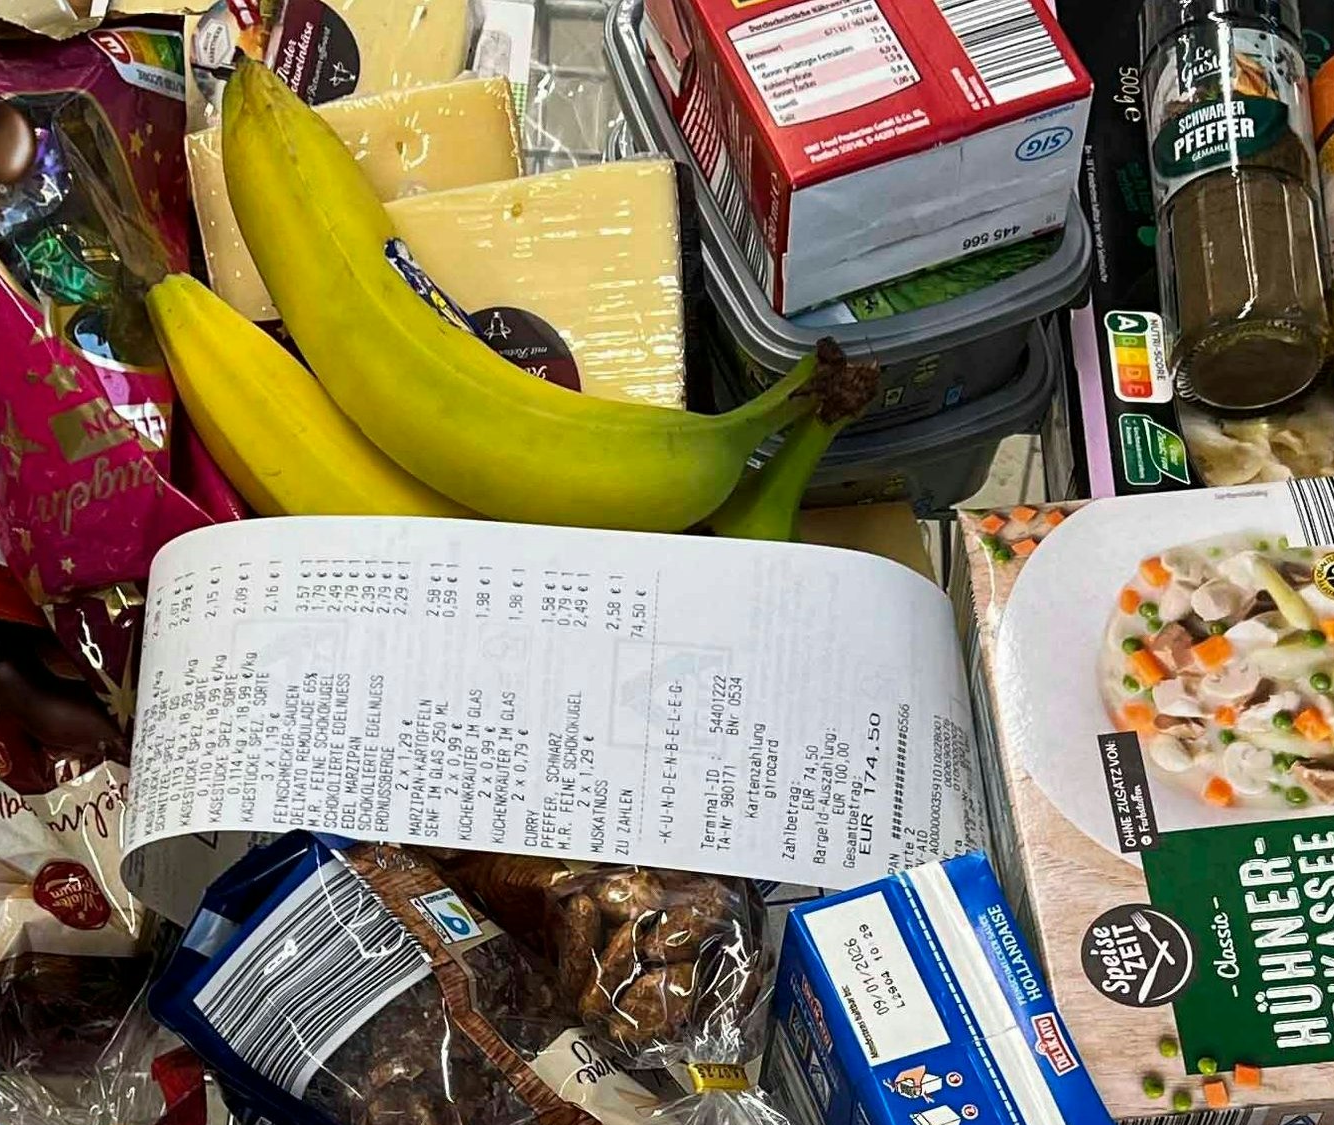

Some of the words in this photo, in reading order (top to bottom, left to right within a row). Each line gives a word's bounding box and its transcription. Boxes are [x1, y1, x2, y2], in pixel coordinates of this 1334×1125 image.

[1026, 135, 1063, 157] SIG
[1174, 118, 1254, 161] PFEFFER
[962, 231, 988, 250] 566
[994, 224, 1020, 240] 445
[1116, 312, 1139, 331] A
[1146, 318, 1168, 381] NUTRI-SCORE
[327, 584, 342, 612] 2,49
[442, 589, 457, 617] 0,59
[475, 591, 490, 618] 1,98
[557, 596, 572, 626] 0,79
[631, 603, 646, 637] 74,50
[303, 671, 317, 693] 65%
[467, 688, 482, 718] GLAS
[727, 676, 742, 706] 0534
[314, 673, 334, 749] SCHOKOKUGEL
[435, 700, 448, 714] ML
[524, 809, 539, 847] CURRY
[540, 596, 556, 623] 1,58
[709, 674, 726, 733] 54401222
[725, 713, 739, 735] BNr
[296, 699, 314, 761] REMOULADE
[432, 720, 446, 742] 250
[466, 724, 479, 738] IM
[590, 779, 608, 853] MUSKATNUSS
[606, 601, 621, 629] 2,58
[310, 755, 326, 791] FEINE
[408, 698, 431, 836] MARZIPAN-KARTOFFELN
[429, 749, 444, 779] GLAS
[545, 732, 562, 782] SCHWARZ
[745, 723, 765, 818] Kartenzahlung
[763, 739, 780, 798] girocard
[803, 745, 820, 780] 74,50
[834, 742, 850, 784] 100,00
[862, 712, 881, 794] 174.50
[290, 767, 307, 825] DELIKATO
[427, 785, 441, 799] IM
[720, 765, 736, 807] 980171
[802, 787, 815, 810] EUR
[813, 726, 838, 864] Bargeld-Auszahlung:
[832, 792, 846, 814] EUR
[1109, 767, 1134, 813] ZUSATZ
[307, 798, 322, 826] M.R.
[424, 808, 440, 837] SENF
[540, 791, 558, 848] PFEFFER,
[617, 788, 632, 833] ZAHLEN
[701, 769, 719, 848] Terminal-ID
[782, 778, 804, 859] Zahlbetrag:
[843, 773, 865, 868] Gesamtbetrag:
[1127, 783, 1154, 834] Farbstoffen
[615, 840, 629, 855] ZU
[717, 815, 732, 850] TA-Nr
[859, 813, 873, 854] EUR
[1117, 816, 1138, 847] OHNE
[986, 903, 1043, 1001] HOLLANDAISE
[1091, 925, 1130, 994] Speise
[1113, 924, 1147, 975] ZEIT
[1211, 912, 1239, 979] Classic
[1239, 837, 1332, 1049] HÜHNER-
[844, 937, 890, 1017] 09/01/2026
[1038, 1016, 1072, 1071] DELIKATO
